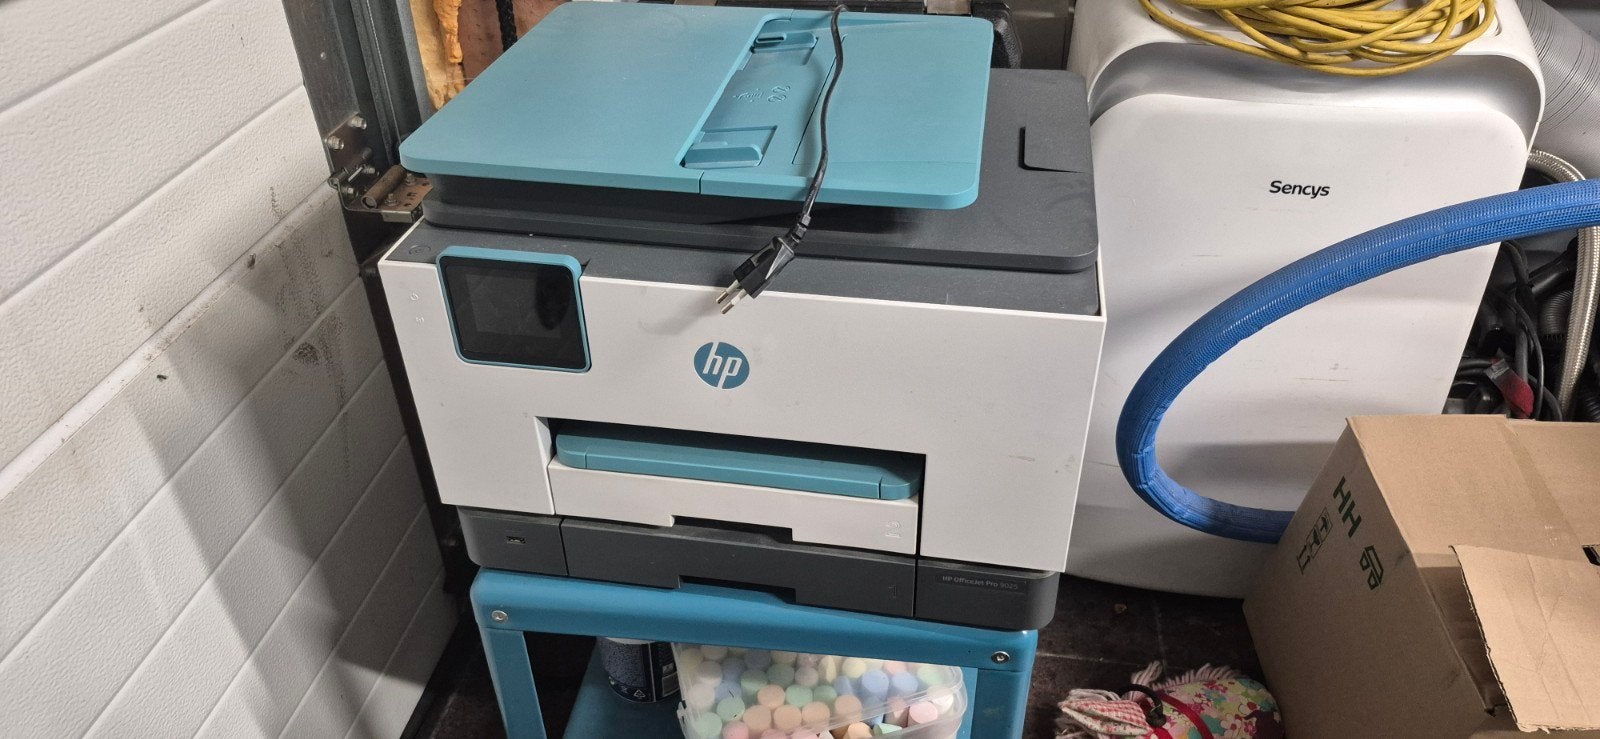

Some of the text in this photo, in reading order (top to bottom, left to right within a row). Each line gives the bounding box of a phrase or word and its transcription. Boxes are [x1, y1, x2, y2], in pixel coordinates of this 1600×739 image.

[1269, 180, 1331, 199] Sencys
[702, 341, 743, 389] hp
[953, 576, 984, 586] OfficeJet
[985, 579, 998, 588] Pro
